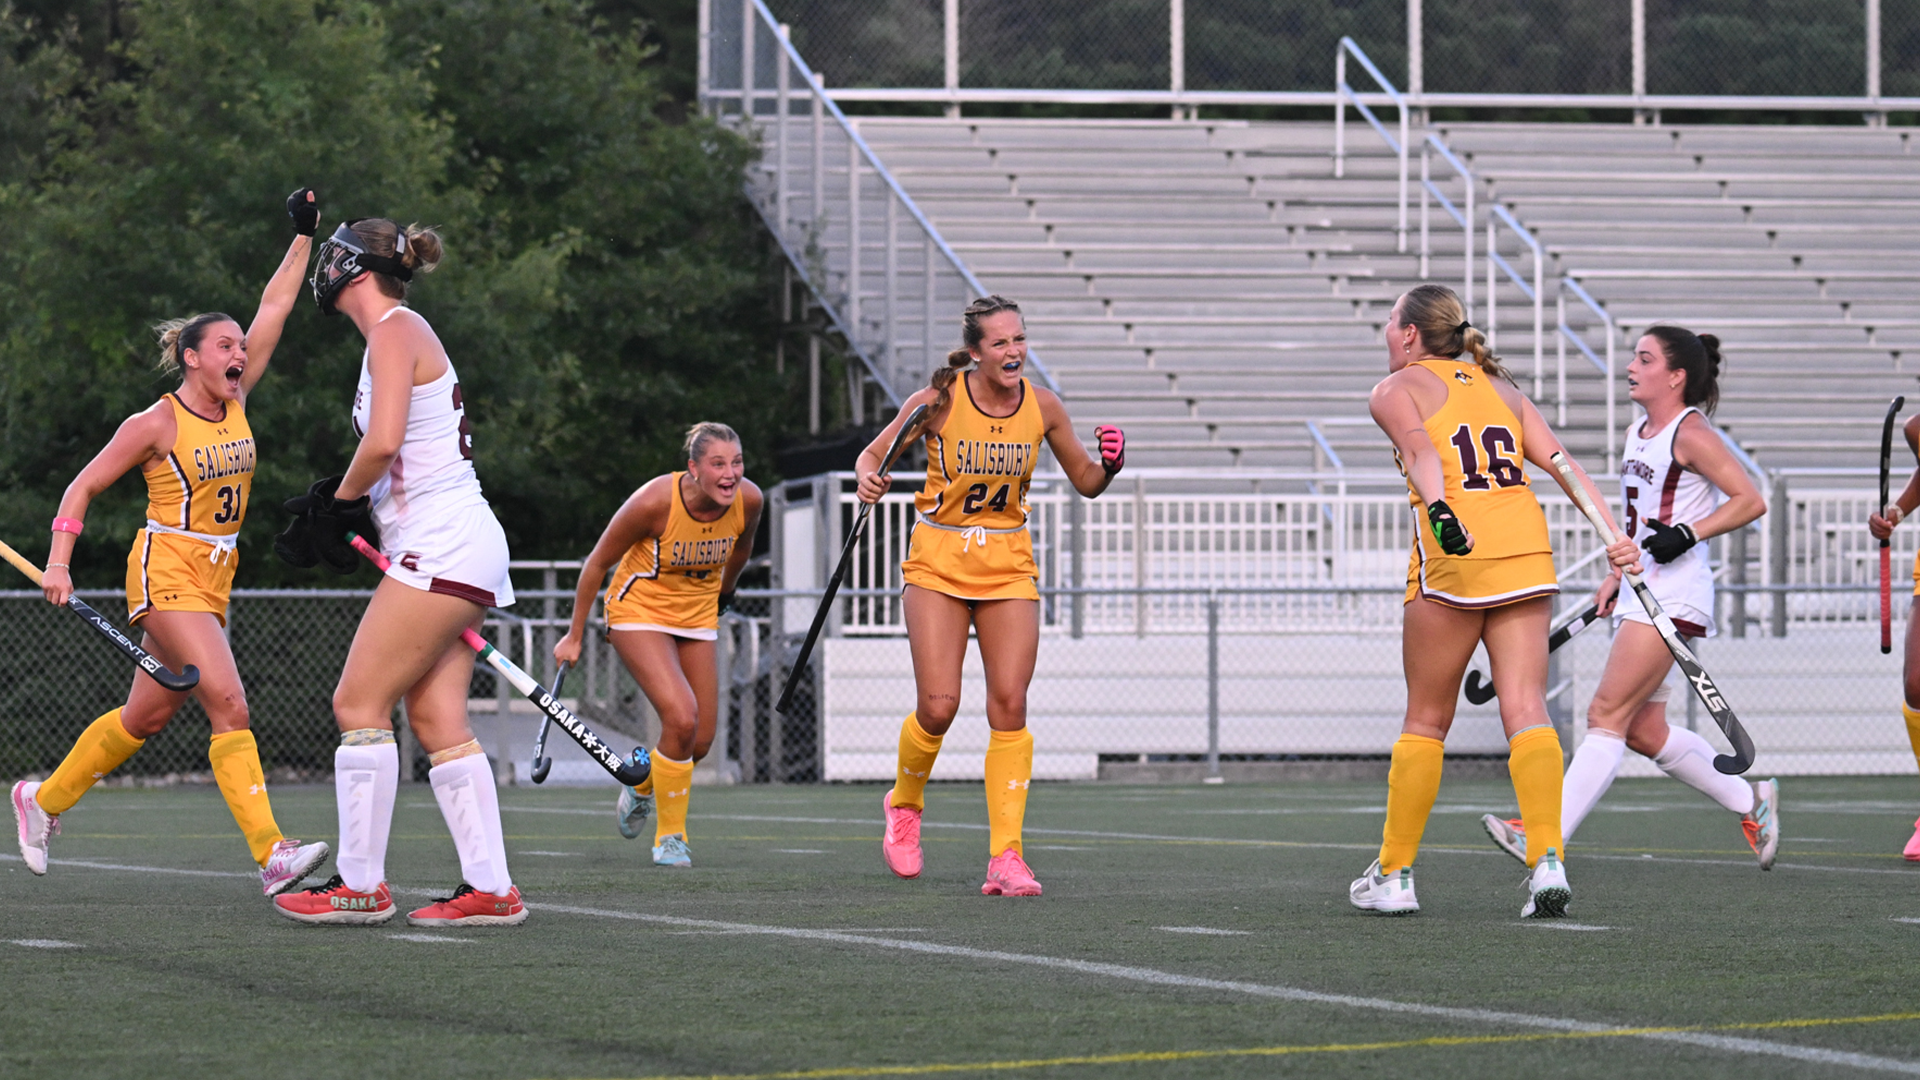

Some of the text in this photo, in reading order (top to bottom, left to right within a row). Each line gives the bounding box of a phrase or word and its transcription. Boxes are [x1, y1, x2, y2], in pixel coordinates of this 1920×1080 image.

[194, 438, 255, 481] SALISBUR
[956, 439, 1032, 477] SALISBURY
[1449, 423, 1528, 492] 16
[213, 483, 242, 524] 31
[962, 482, 1011, 515] 24
[90, 616, 145, 656] ASCENT
[1689, 670, 1728, 713] STX
[539, 693, 585, 738] OSAKA
[593, 743, 624, 772] 大阪
[262, 861, 285, 881] OSAKA
[330, 896, 377, 910] OSAKA
